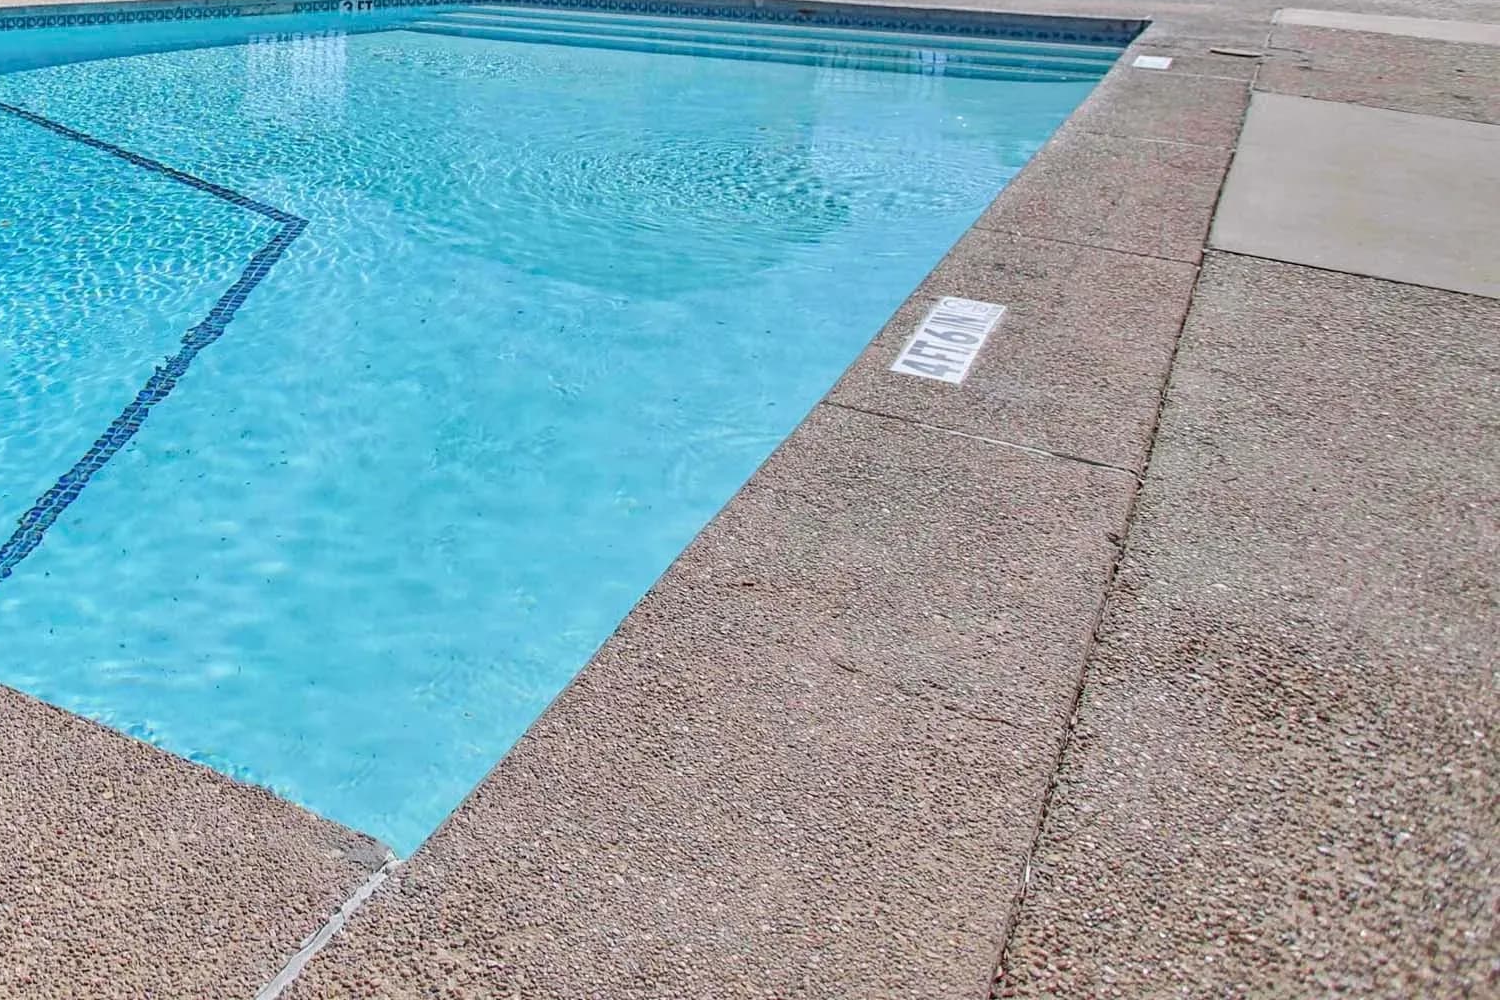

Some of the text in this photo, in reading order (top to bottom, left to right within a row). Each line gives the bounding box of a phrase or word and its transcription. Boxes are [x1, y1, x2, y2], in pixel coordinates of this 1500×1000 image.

[900, 311, 989, 378] 4 FT 6 IN
